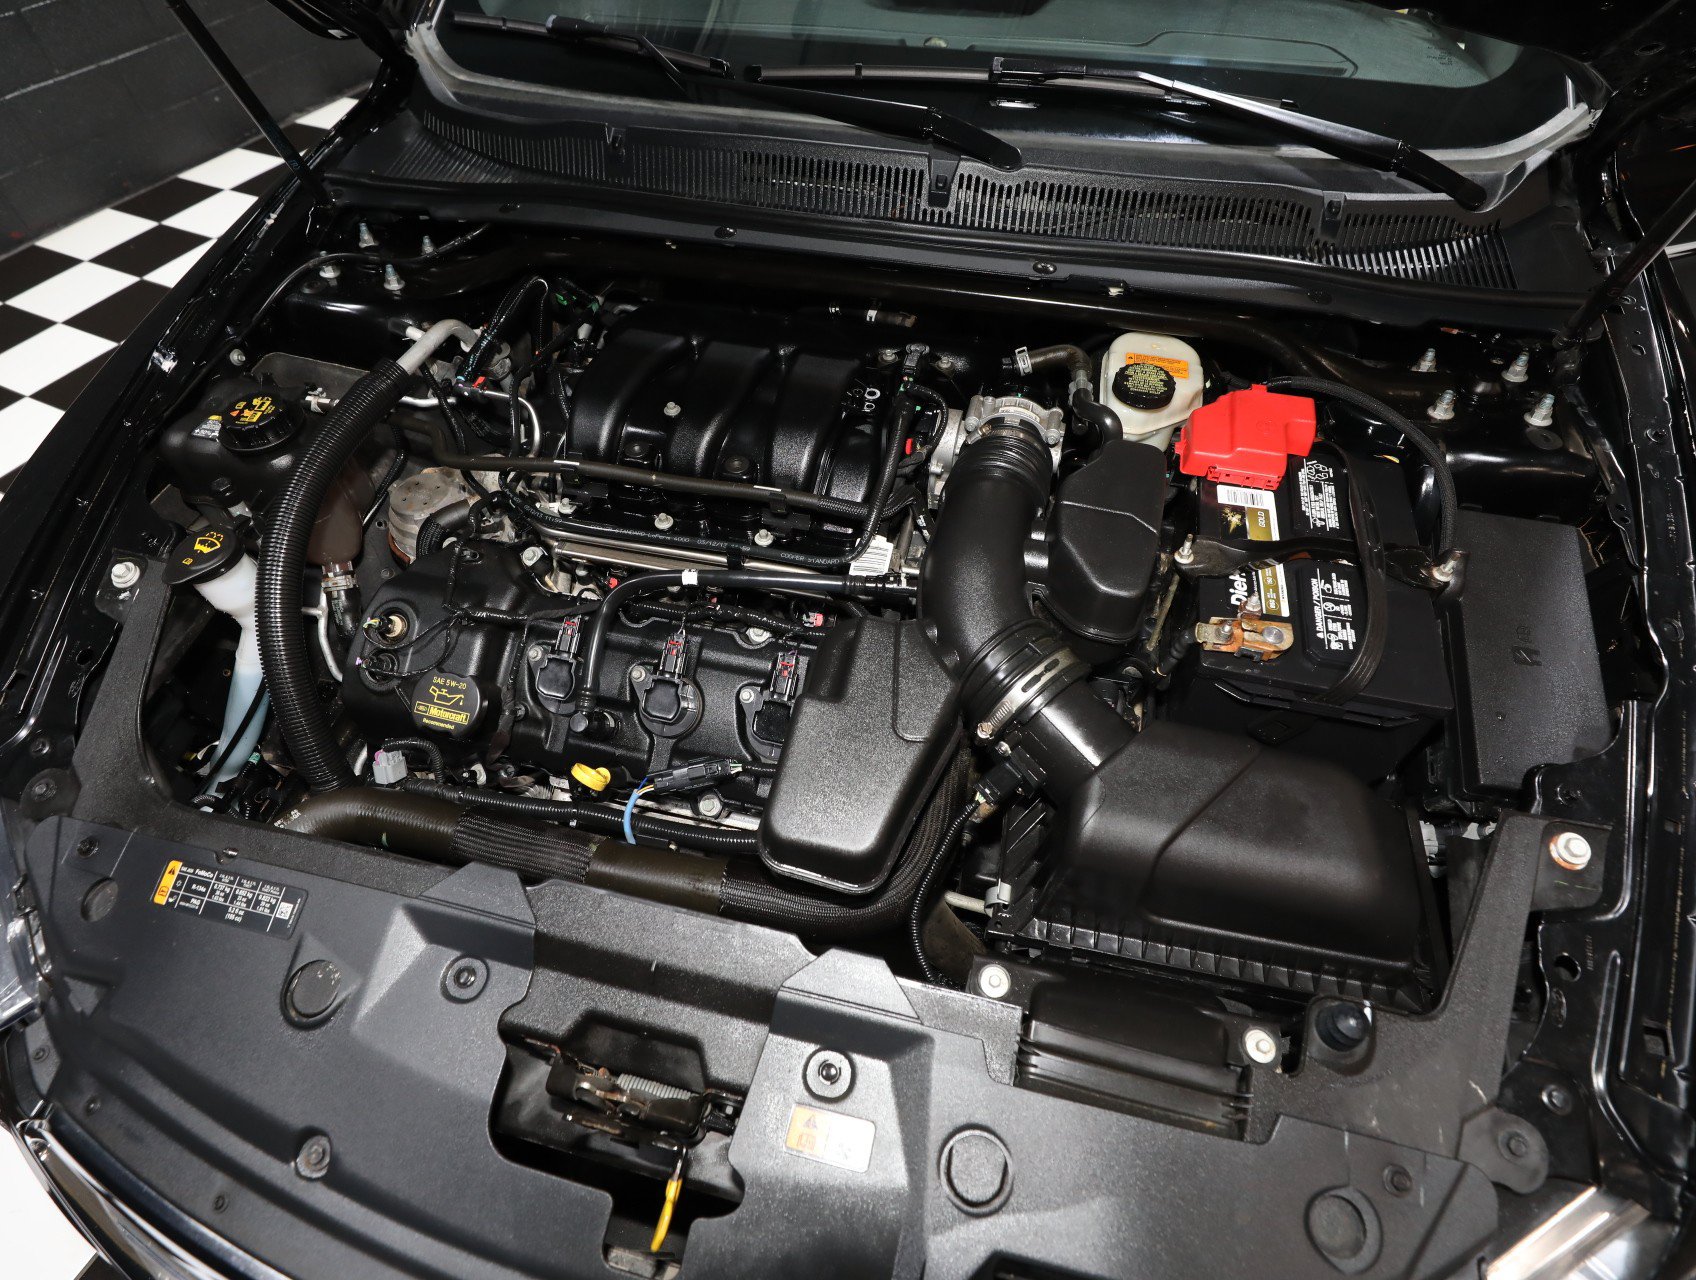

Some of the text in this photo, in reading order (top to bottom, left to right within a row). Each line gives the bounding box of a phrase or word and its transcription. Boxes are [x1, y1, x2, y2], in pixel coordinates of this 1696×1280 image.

[1257, 511, 1266, 528] GOLD
[433, 676, 467, 690] SAE 5W-20
[429, 706, 467, 723] Motorcraft
[423, 718, 455, 730] Recommended
[195, 868, 214, 878] FoMoCo
